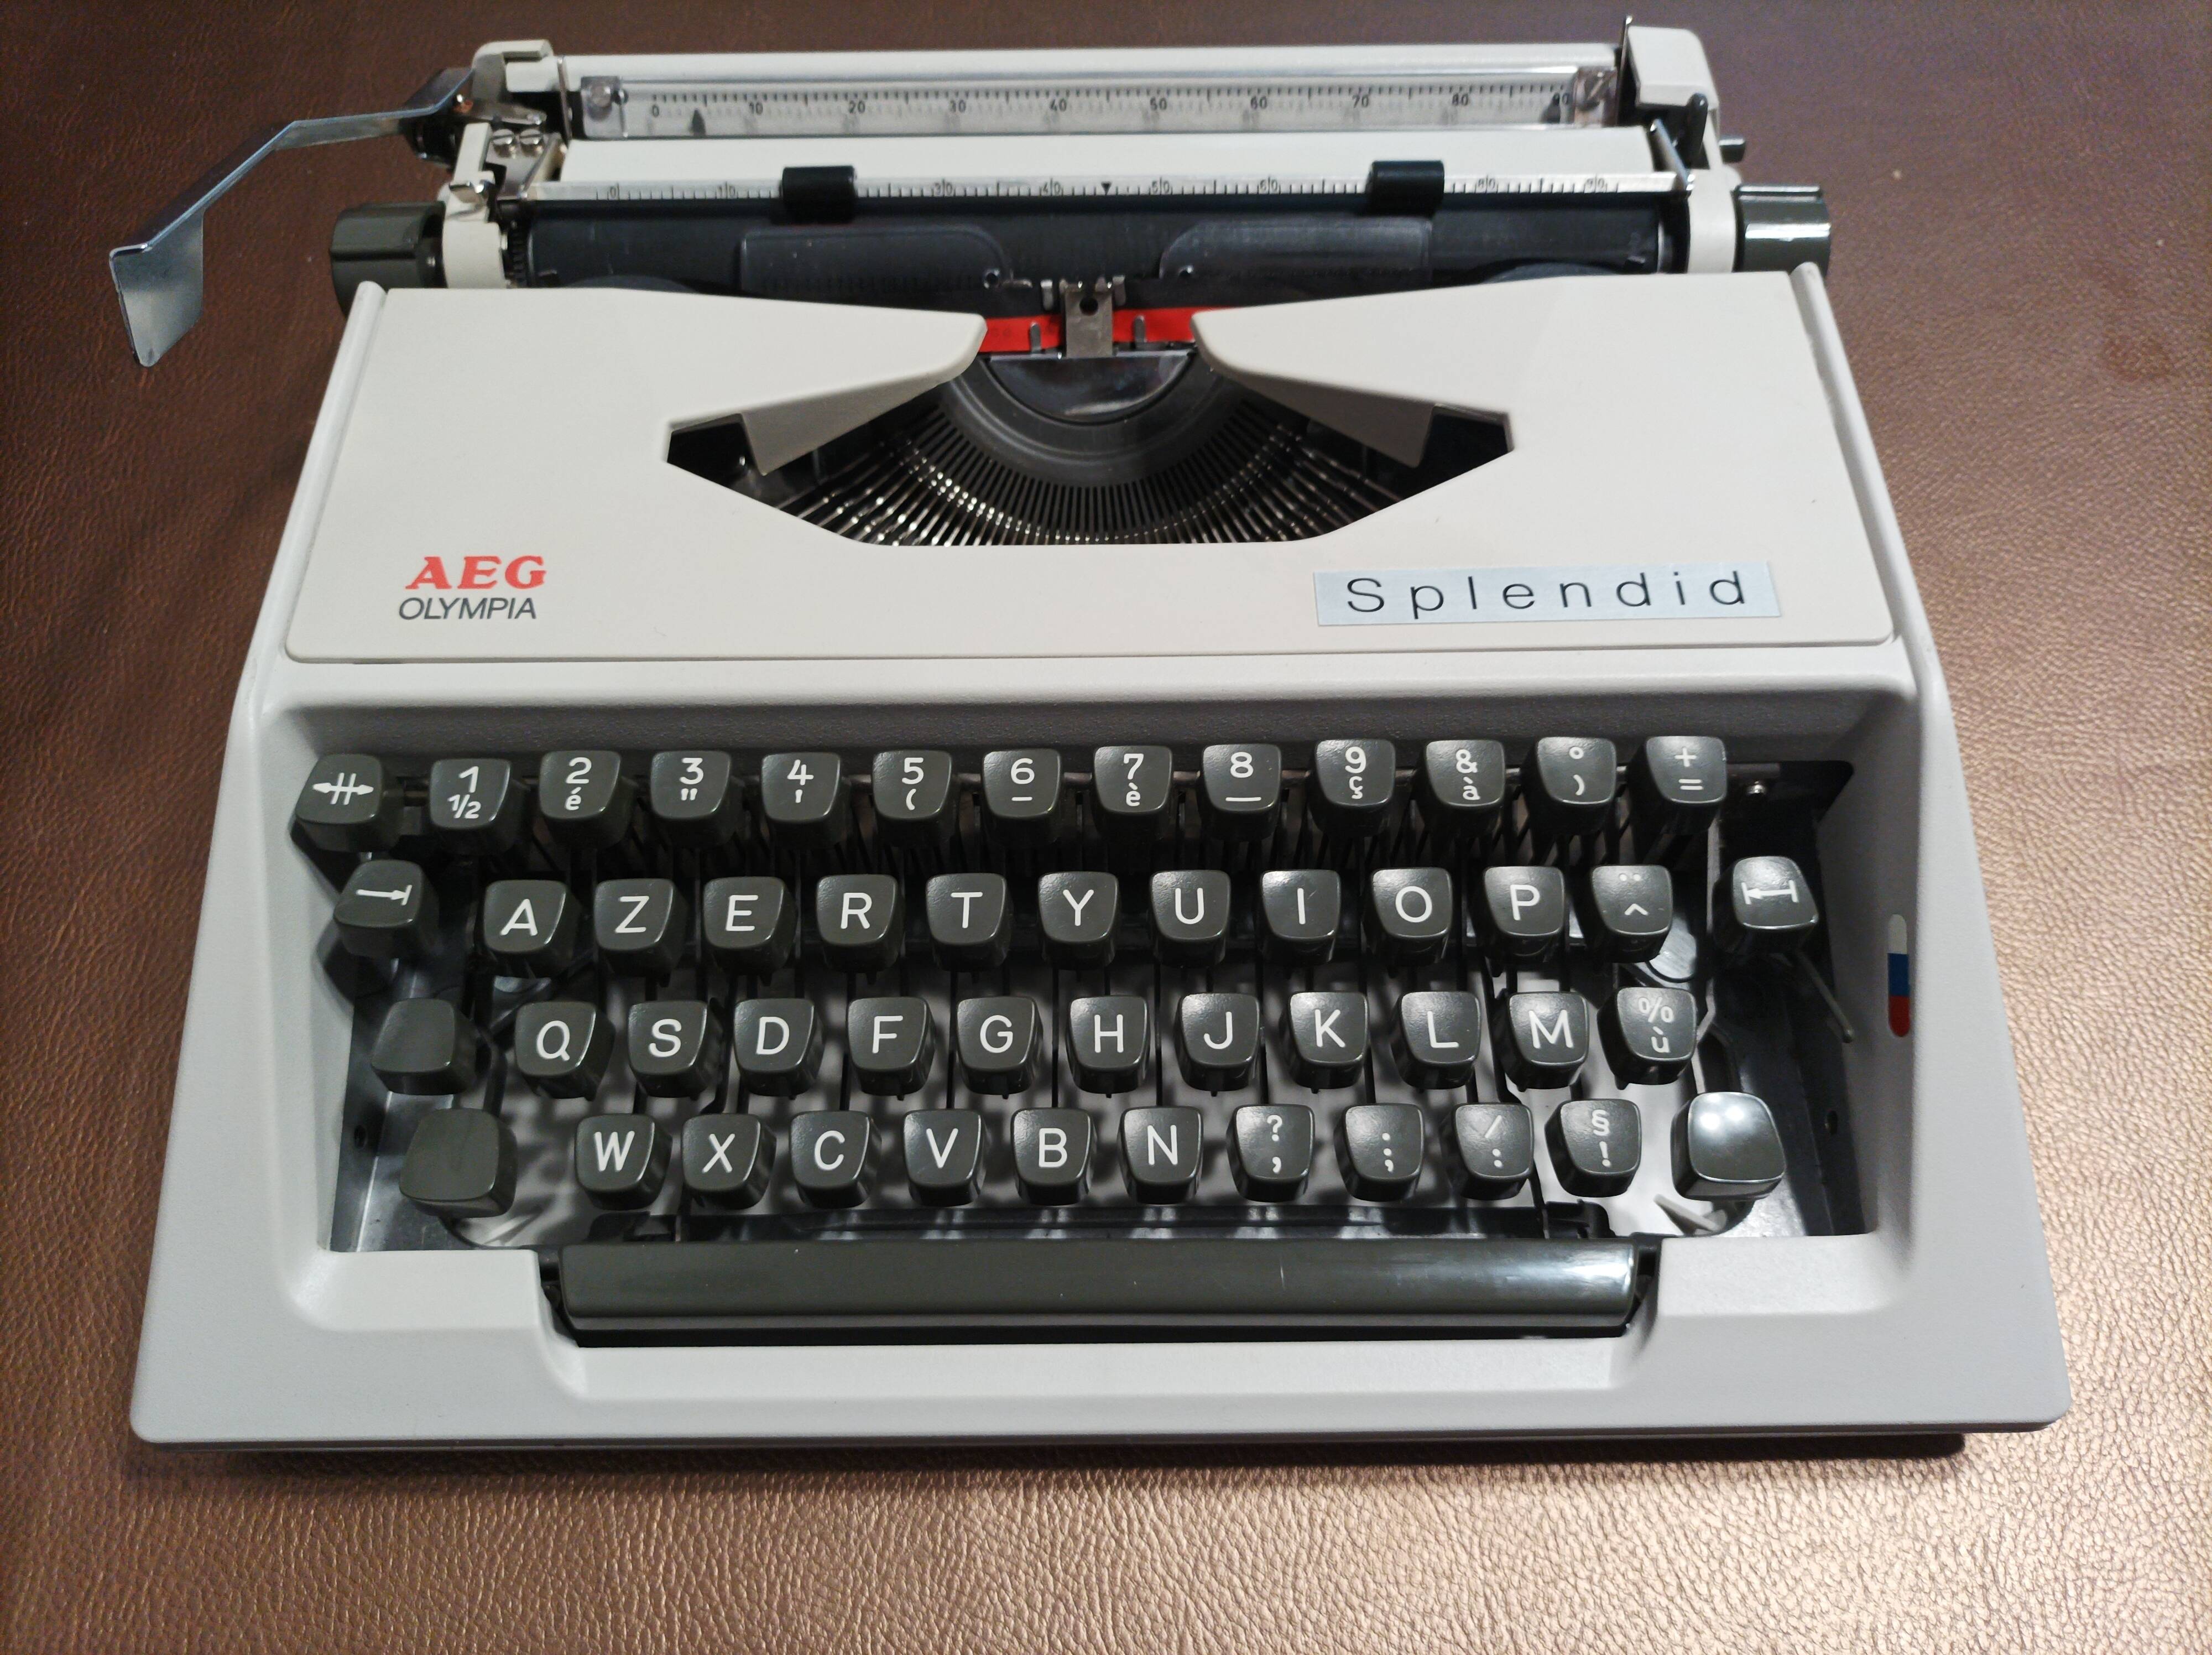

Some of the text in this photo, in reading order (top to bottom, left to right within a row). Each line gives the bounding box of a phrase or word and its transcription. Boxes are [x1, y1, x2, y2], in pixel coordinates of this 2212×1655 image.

[652, 105, 660, 118] 0
[749, 102, 763, 115] 10
[849, 101, 865, 113] 20
[949, 99, 966, 113] 30
[1050, 98, 1067, 112] 40
[1150, 97, 1167, 111] 50
[1250, 96, 1267, 110] 60
[1352, 95, 1369, 108] 70
[1452, 93, 1468, 106] 80
[405, 555, 547, 589] AEG
[399, 597, 536, 620] OLYMPIA
[1346, 570, 1745, 620] Splendid
[565, 757, 592, 784] 2
[680, 758, 704, 784] 3
[902, 757, 924, 784] 5
[1010, 758, 1035, 784] 6
[1123, 753, 1144, 780] 7
[1230, 752, 1254, 778] 8
[1345, 747, 1366, 774] 9
[1455, 750, 1478, 773] &
[1675, 748, 1697, 767] +
[458, 766, 479, 793] 1
[787, 759, 814, 785] 4
[1574, 774, 1585, 796] )
[1678, 778, 1704, 790] =
[565, 787, 581, 810] é
[906, 789, 916, 810] (
[1126, 783, 1140, 806] è
[1349, 776, 1363, 799] ç
[1462, 777, 1480, 800] à
[614, 896, 649, 933] Z
[726, 894, 759, 931] E
[841, 892, 872, 929] R
[951, 892, 983, 929] T
[1063, 889, 1094, 926] Y
[1175, 888, 1205, 925] U
[1297, 888, 1306, 925] I
[1395, 886, 1433, 923] O
[1510, 884, 1540, 920] P
[500, 899, 538, 936] A
[1638, 996, 1674, 1023] %
[536, 1021, 570, 1062] Q
[649, 1019, 682, 1058] S
[755, 1016, 790, 1055] D
[872, 1015, 903, 1053] F
[980, 1015, 1014, 1053] G
[1094, 1014, 1124, 1053] H
[1203, 1011, 1232, 1050] J
[1314, 1009, 1345, 1047] K
[1427, 1011, 1459, 1048] L
[1528, 1009, 1574, 1049] M
[1651, 1026, 1670, 1053] ù
[1266, 1115, 1283, 1142] ?
[1485, 1115, 1503, 1138] /
[1592, 1109, 1610, 1136] §
[593, 1130, 635, 1172] W
[702, 1133, 735, 1173] X
[813, 1130, 846, 1170] C
[926, 1128, 958, 1169] V
[1039, 1128, 1068, 1168] B
[1147, 1125, 1178, 1165] N
[1492, 1148, 1503, 1168] :
[1599, 1141, 1611, 1167] !
[1272, 1156, 1281, 1174] ,
[1383, 1148, 1395, 1173] ;
